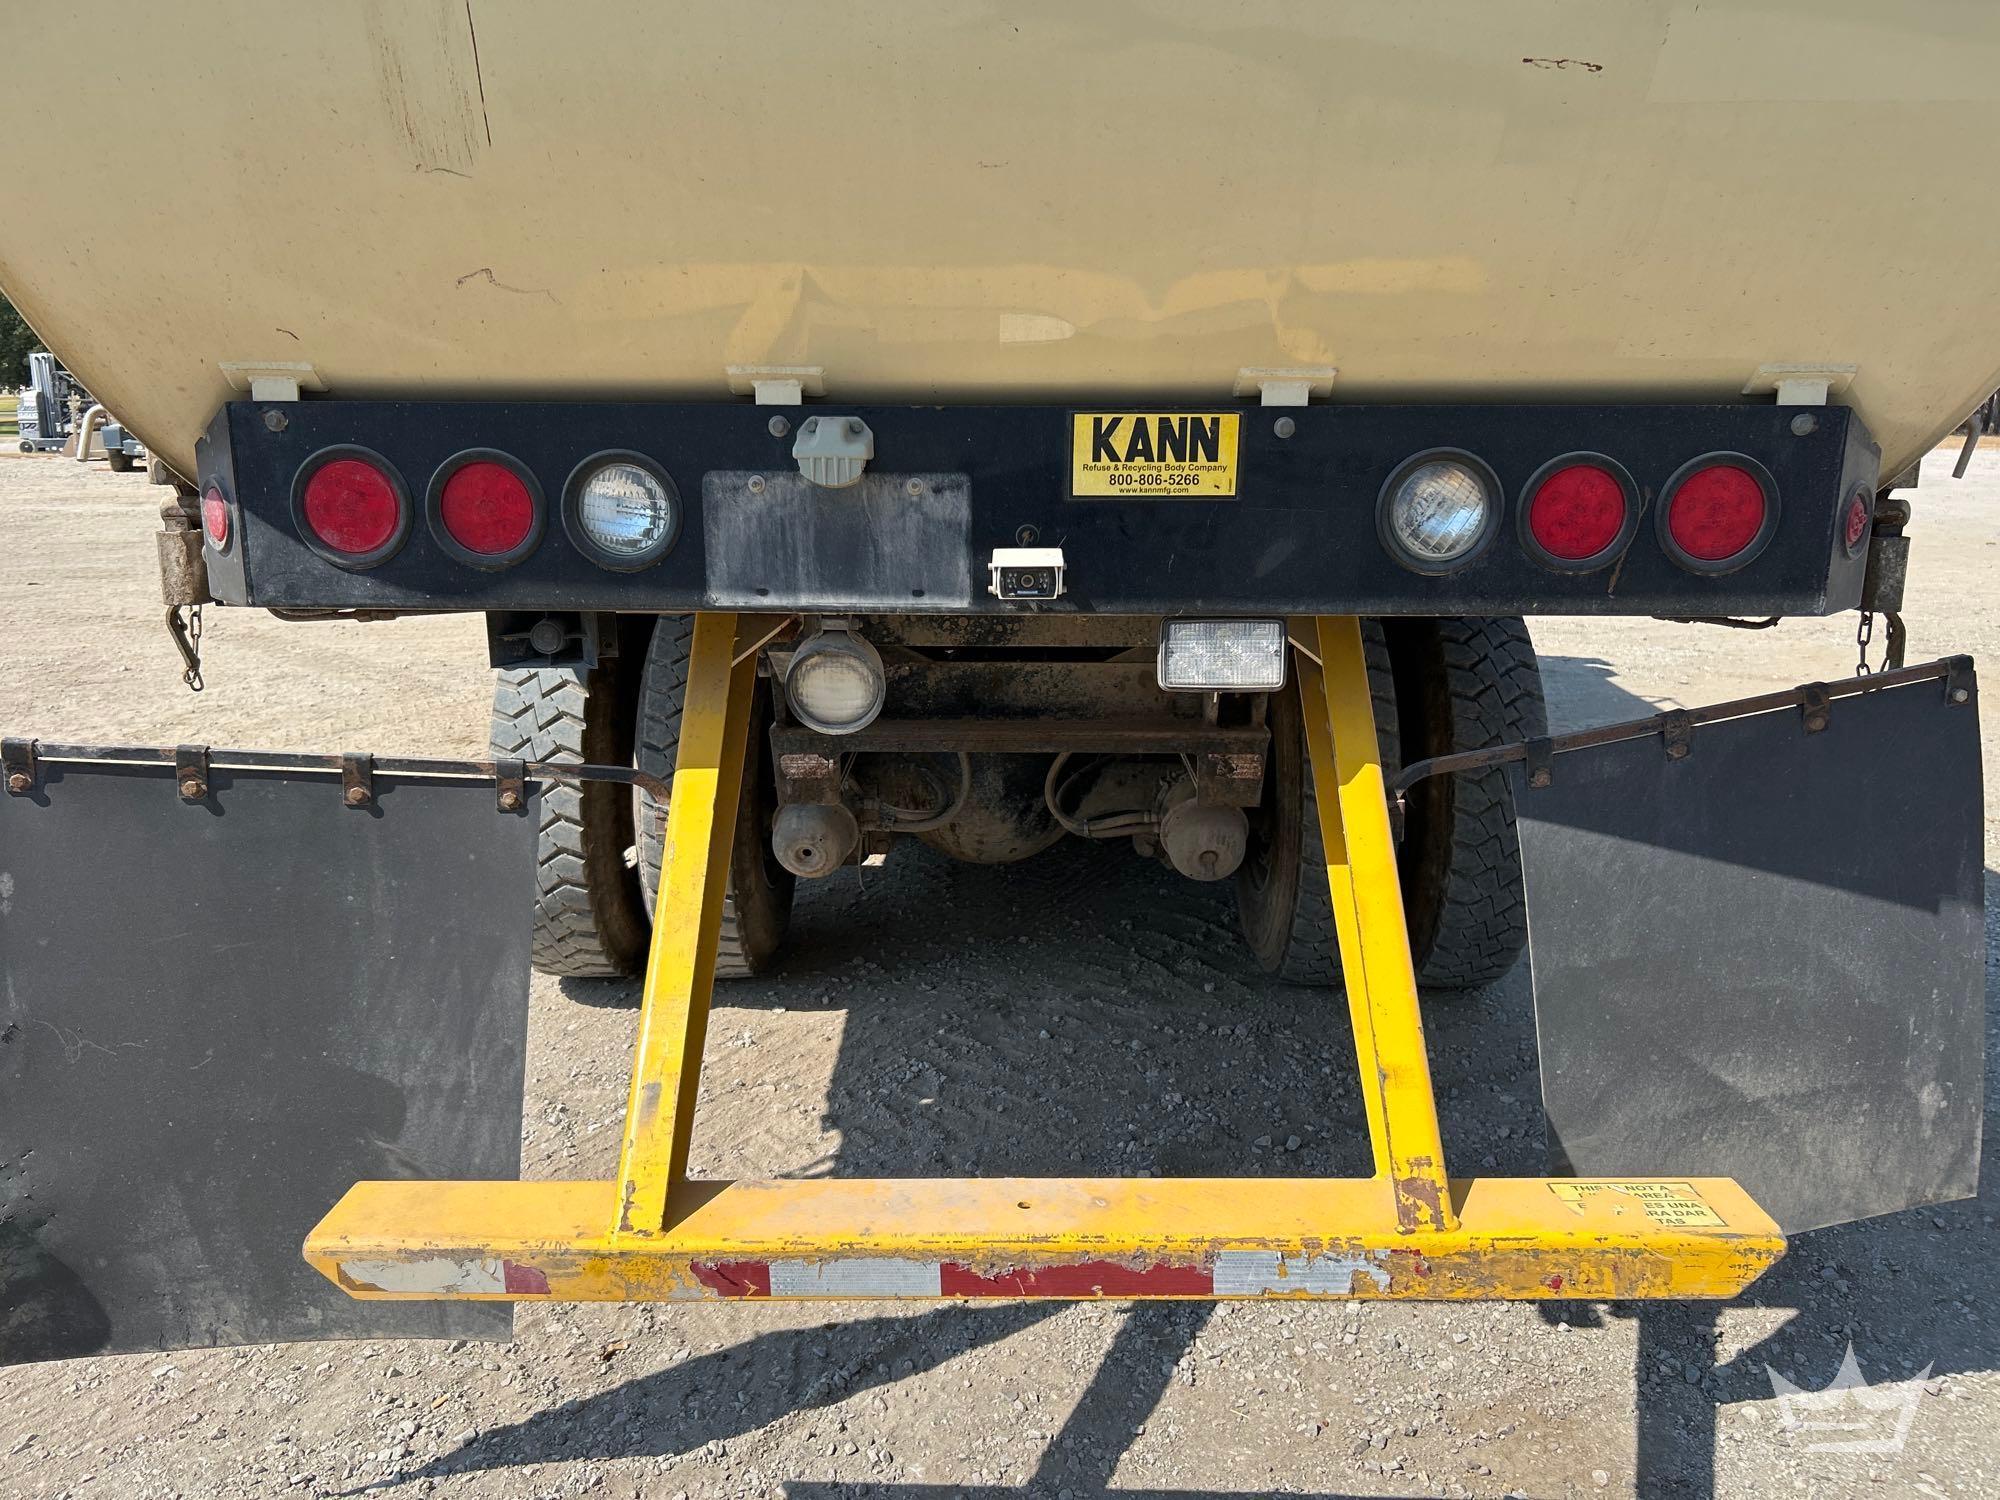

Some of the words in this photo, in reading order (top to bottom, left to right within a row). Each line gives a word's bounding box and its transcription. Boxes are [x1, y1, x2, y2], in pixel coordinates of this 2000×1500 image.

[1092, 416, 1221, 463] KANN
[1082, 463, 1111, 472] Refuse
[1113, 463, 1120, 472] &
[1122, 463, 1162, 473] Recycling
[1164, 463, 1187, 473] Body
[1188, 464, 1228, 473] Company
[1109, 473, 1200, 486] 800-806-5266
[1119, 486, 1189, 495] www.kannmfg.com
